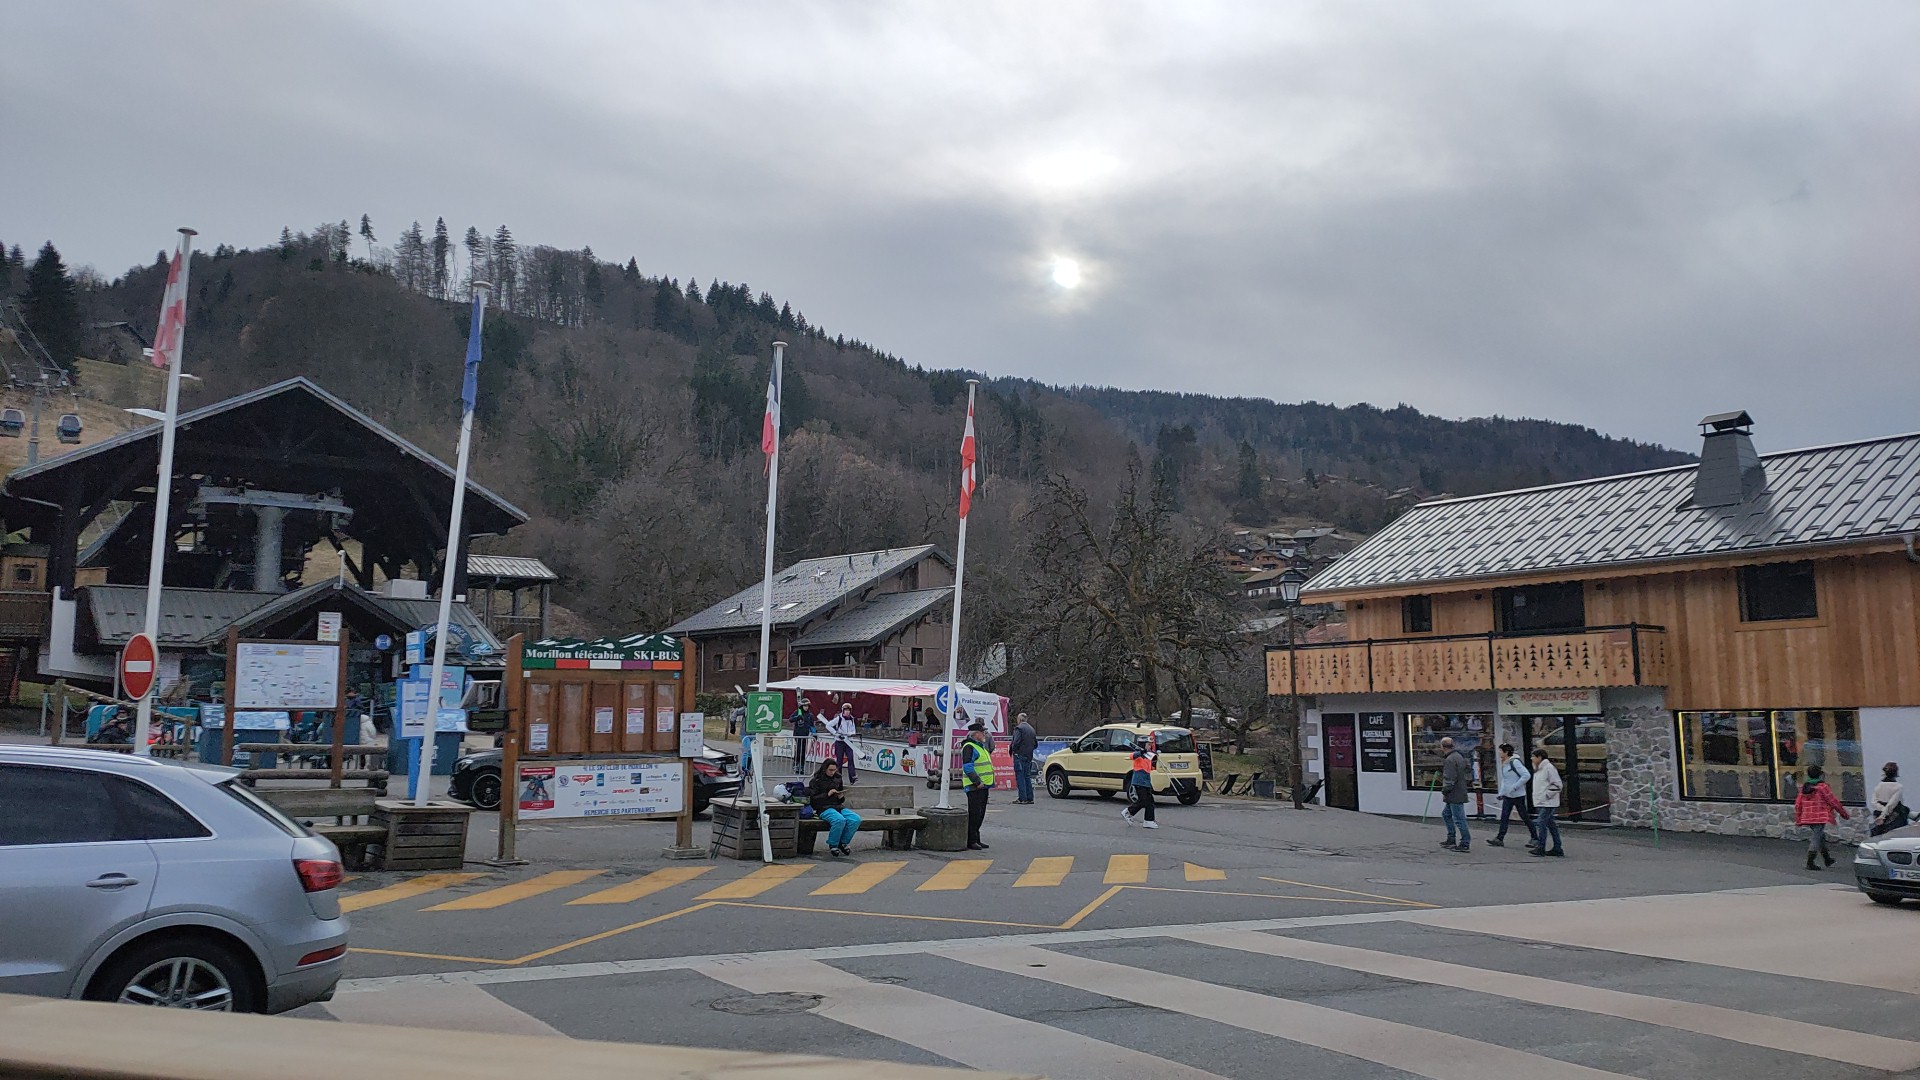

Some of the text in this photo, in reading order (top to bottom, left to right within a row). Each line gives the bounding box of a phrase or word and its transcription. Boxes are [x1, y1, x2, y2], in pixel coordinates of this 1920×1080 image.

[525, 649, 572, 659] Morillon
[574, 650, 626, 660] télécabine
[1369, 714, 1384, 725] CAFÉ
[621, 806, 656, 814] PARTENAIRES
